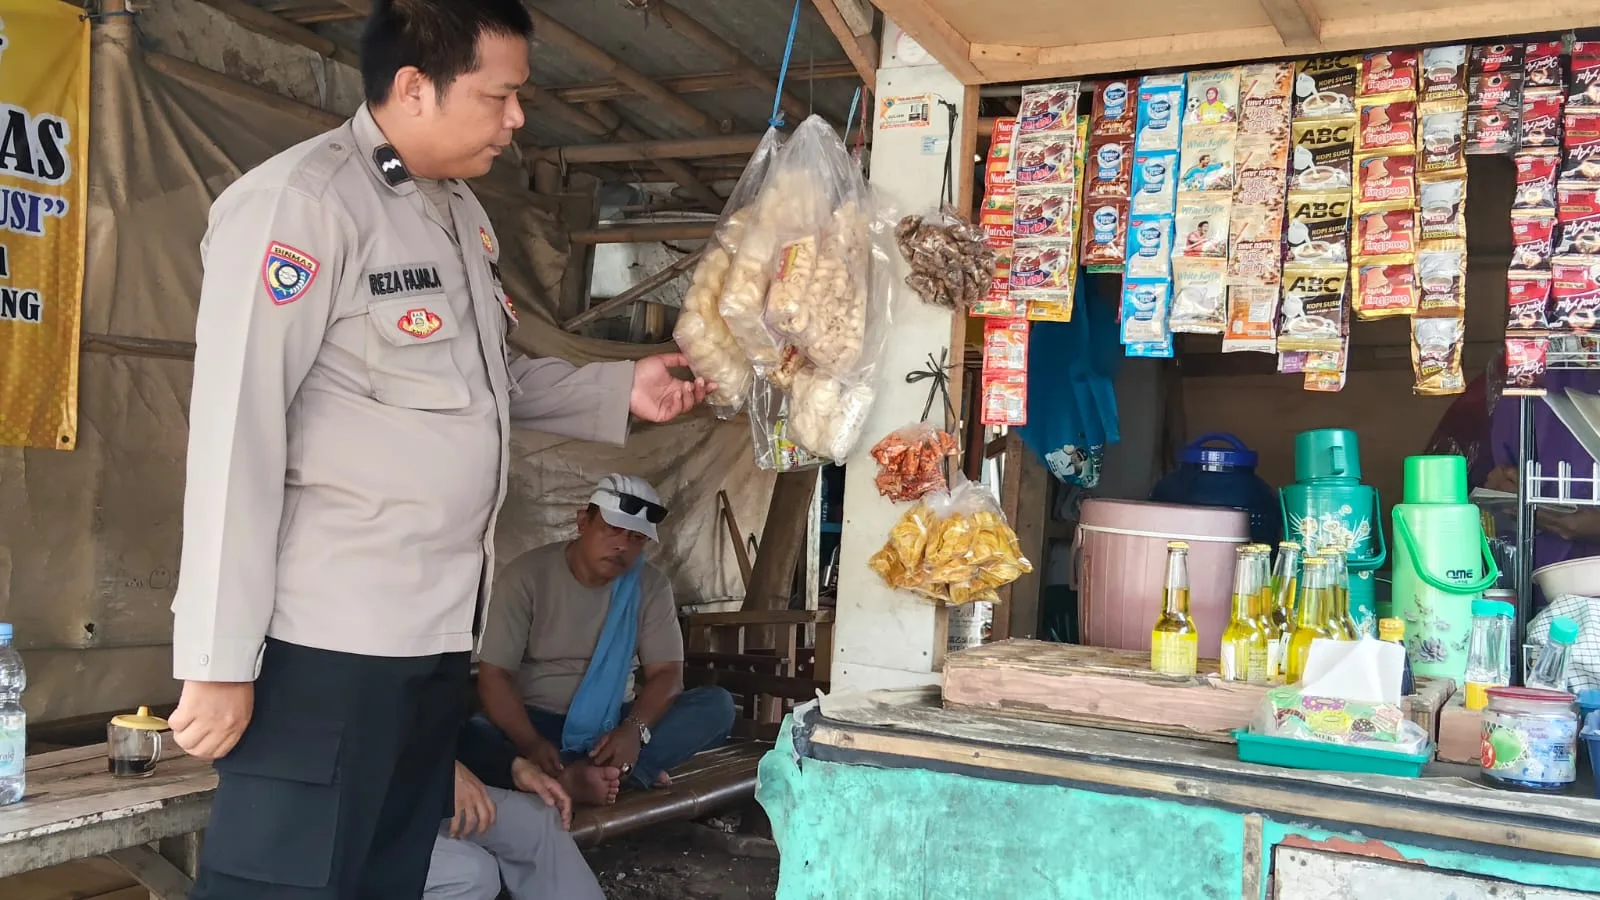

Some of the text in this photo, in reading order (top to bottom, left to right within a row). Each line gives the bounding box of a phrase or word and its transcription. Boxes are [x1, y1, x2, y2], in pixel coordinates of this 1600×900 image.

[1300, 56, 1349, 72] ABC
[1575, 68, 1599, 84] Api
[1297, 126, 1350, 145] ABC
[1568, 145, 1592, 160] Api
[1293, 201, 1345, 218] ABC
[1563, 221, 1586, 236] Api
[274, 247, 312, 269] BINMAS
[369, 270, 403, 296] REZA
[1288, 276, 1341, 293] ABC
[1556, 297, 1579, 312] Api
